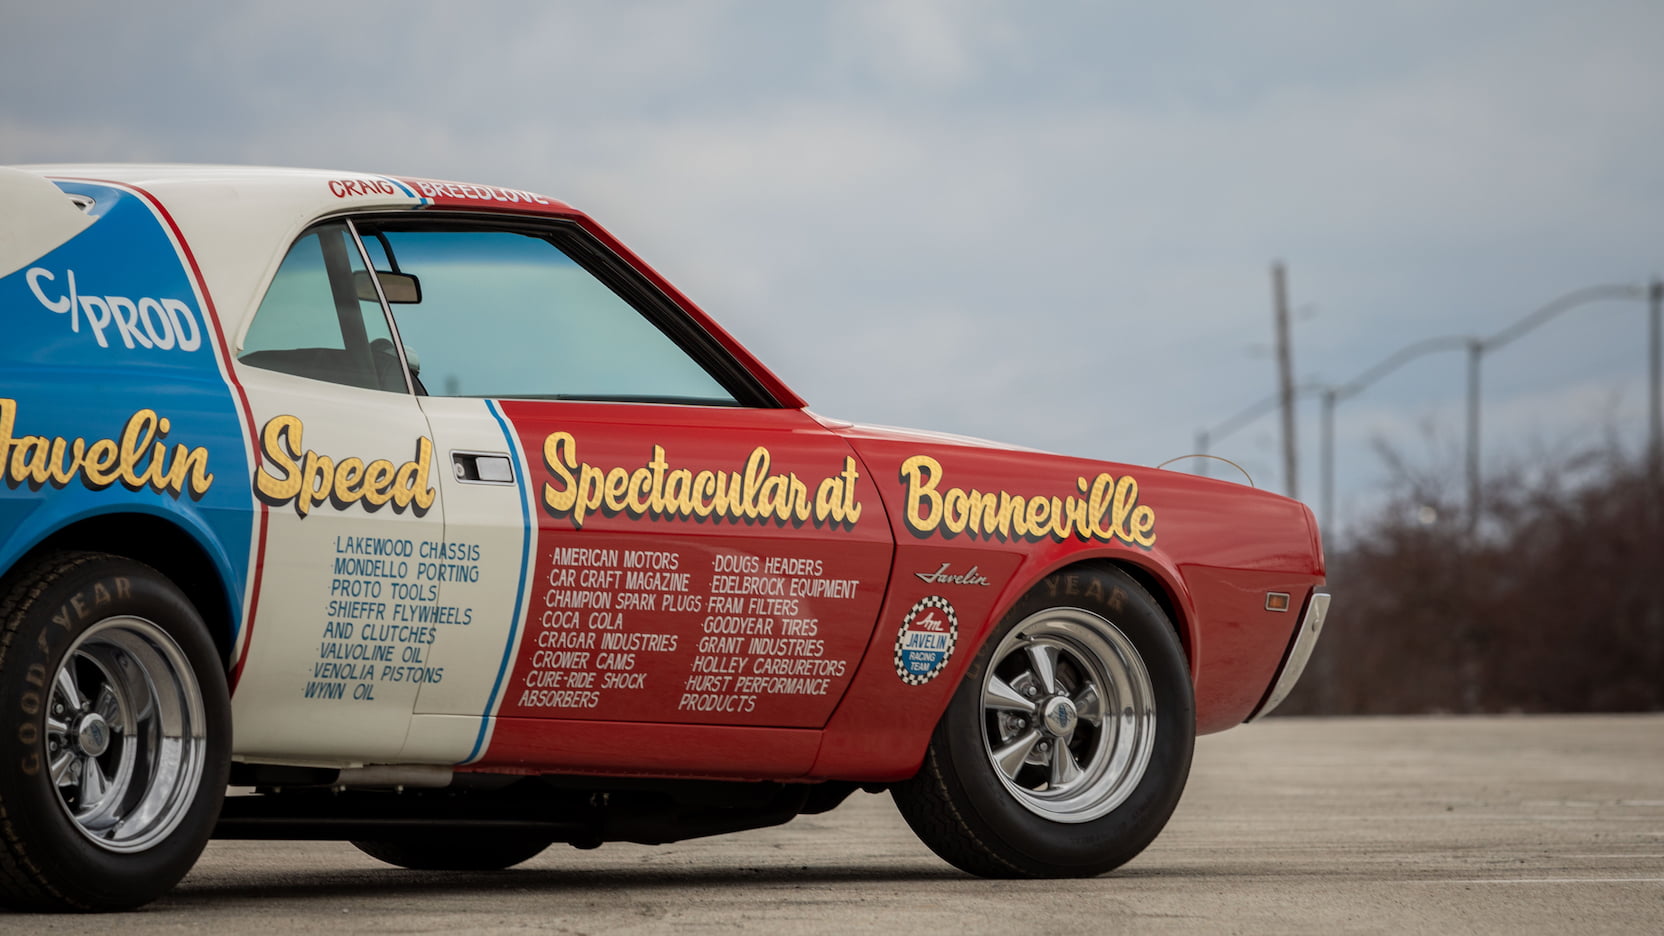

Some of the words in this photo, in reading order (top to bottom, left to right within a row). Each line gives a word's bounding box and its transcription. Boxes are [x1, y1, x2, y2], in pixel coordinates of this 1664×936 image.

[328, 180, 394, 199] CRAIG
[416, 181, 549, 205] BREEDLOVE
[26, 267, 201, 351] C/PROD
[254, 413, 436, 519] Speed
[542, 431, 812, 530] Spectacular
[814, 455, 862, 532] at
[899, 454, 1157, 551] Bonneville
[336, 535, 413, 558] LAKEWOOD
[419, 541, 481, 562] CHASSIS
[552, 547, 618, 568] AMERICAN
[623, 550, 679, 570] MOTORS
[333, 557, 408, 579] MONDELLO
[417, 562, 479, 583] PORTING
[714, 554, 759, 573] DOUGS
[764, 556, 823, 576] HEADERS
[914, 562, 991, 586] Javelin
[330, 578, 382, 599] PROTO
[391, 582, 437, 602] TOOLS
[549, 568, 576, 588] CAR
[580, 570, 623, 589] CRAFT
[625, 571, 690, 592] MAGAZINE
[711, 575, 785, 597] EDELBROCK
[790, 577, 860, 600] EQUIPMENT
[545, 589, 612, 609] CHAMPION
[615, 592, 656, 611] SPARK
[661, 594, 702, 613] PLUGS
[707, 596, 744, 614] FRAM
[748, 598, 799, 616] FILTERS
[327, 600, 386, 621] SHIEFFR
[393, 603, 473, 626] FLYWHEELS
[542, 610, 579, 629] COCA
[588, 611, 623, 630] COLA
[323, 621, 354, 640] AND
[361, 623, 437, 645] CLUTCHES
[703, 616, 774, 636] GOODYEAR
[781, 618, 818, 637] TIRES
[538, 631, 596, 649] CRAGAR
[601, 632, 678, 652] INDUSTRIES
[699, 636, 745, 654] GRANT
[748, 637, 824, 657] INDUSTRIES
[905, 632, 948, 650] JAVELIN
[320, 642, 395, 662] VALVOLINE
[402, 646, 423, 664] OIL
[532, 650, 590, 669] CROWER
[596, 653, 636, 670] CAMS
[908, 650, 936, 662] RACING
[314, 662, 375, 681] VENOLIA
[380, 665, 444, 684] PISTONS
[692, 655, 748, 674] HOLLEY
[753, 657, 847, 677] CARBURETORS
[910, 661, 931, 672] TEAM
[525, 670, 597, 688] CURE-RIDE
[600, 672, 647, 689] SHOCK
[685, 675, 733, 692] HURST
[734, 676, 831, 695] PERFORMANCE
[304, 681, 346, 700] WYNN
[353, 683, 375, 701] OIL
[518, 689, 600, 709] ABSORBERS
[678, 693, 757, 712] PRODUCTS
